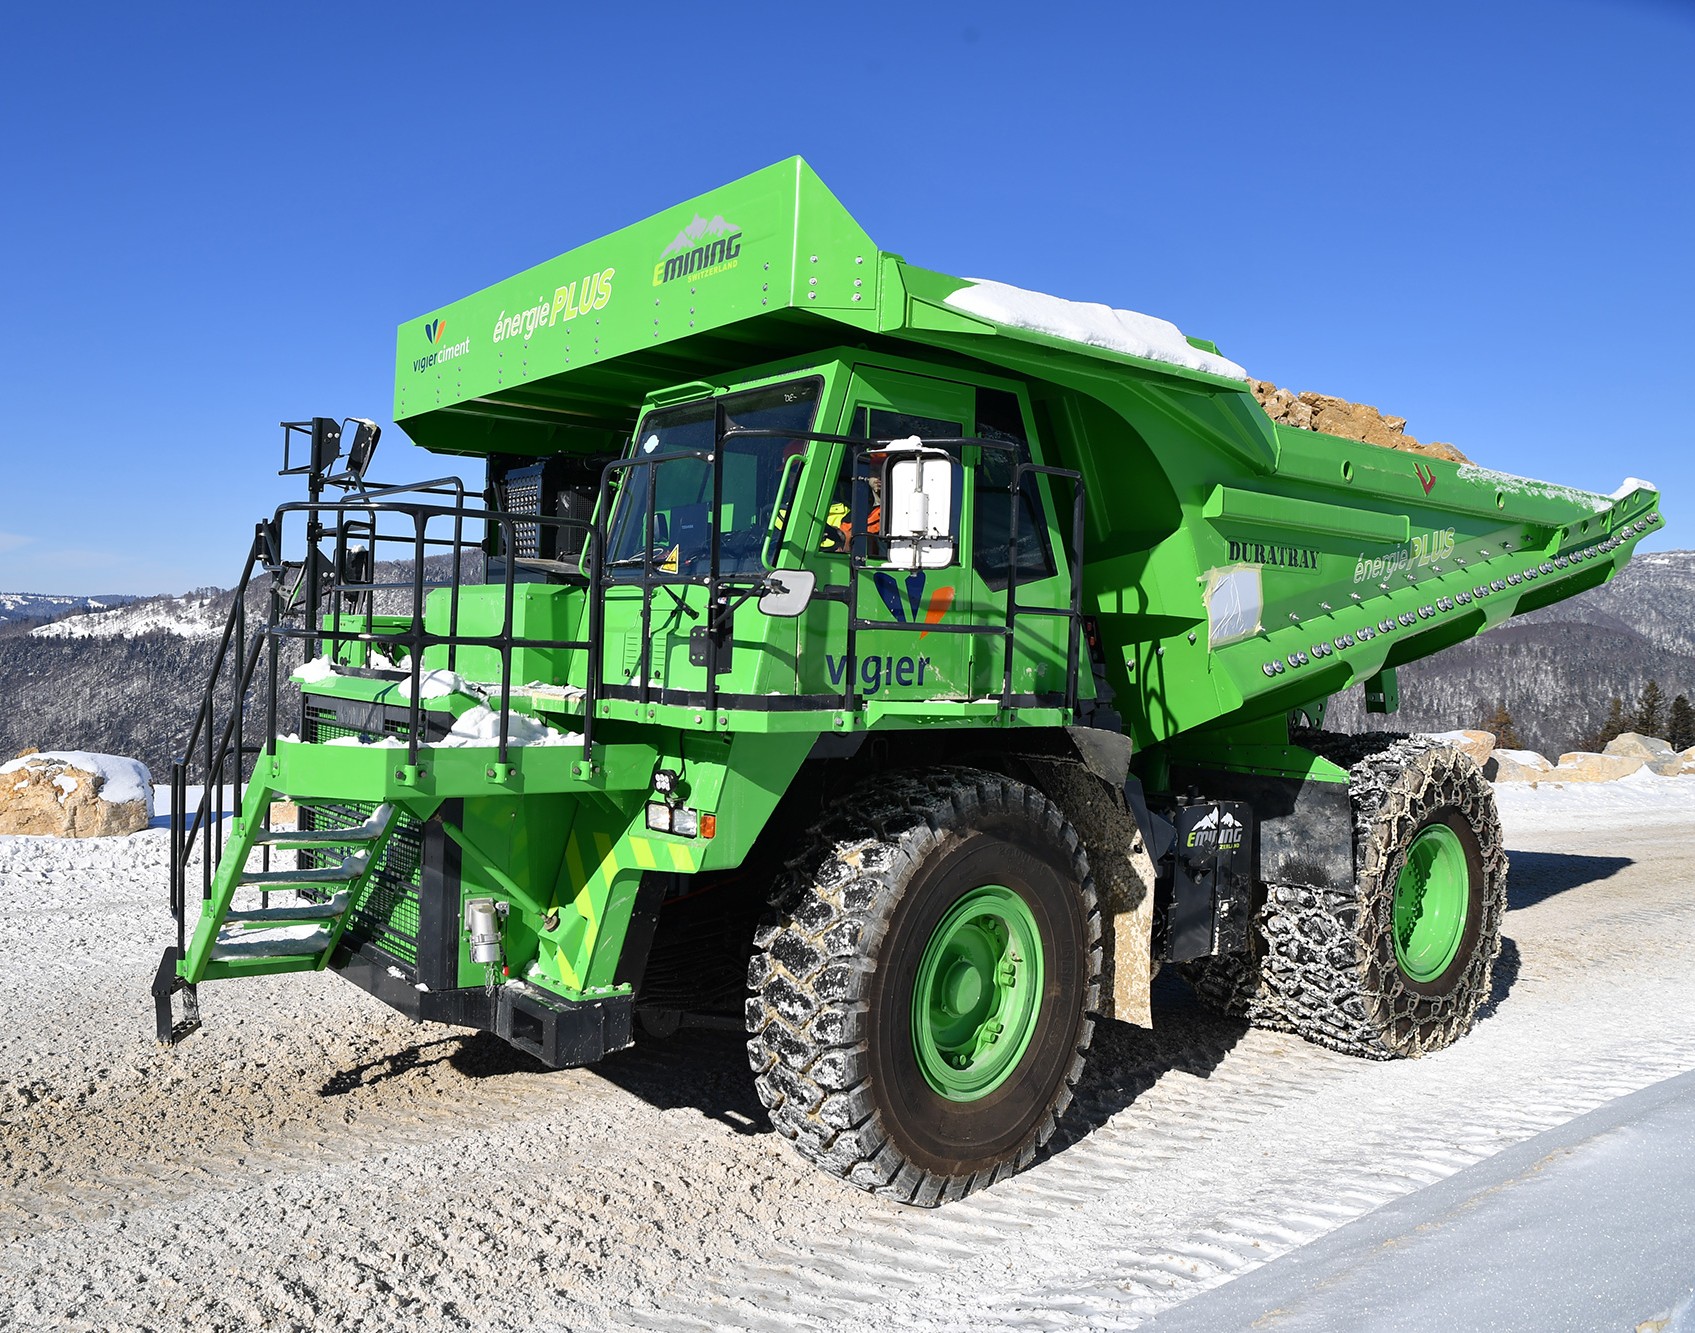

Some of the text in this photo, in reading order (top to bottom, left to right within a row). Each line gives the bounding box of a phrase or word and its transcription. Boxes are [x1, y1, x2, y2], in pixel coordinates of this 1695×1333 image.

[652, 232, 743, 287] EMINING
[687, 259, 738, 283] SWITZERLAND
[1228, 541, 1321, 570] DURATRAY
